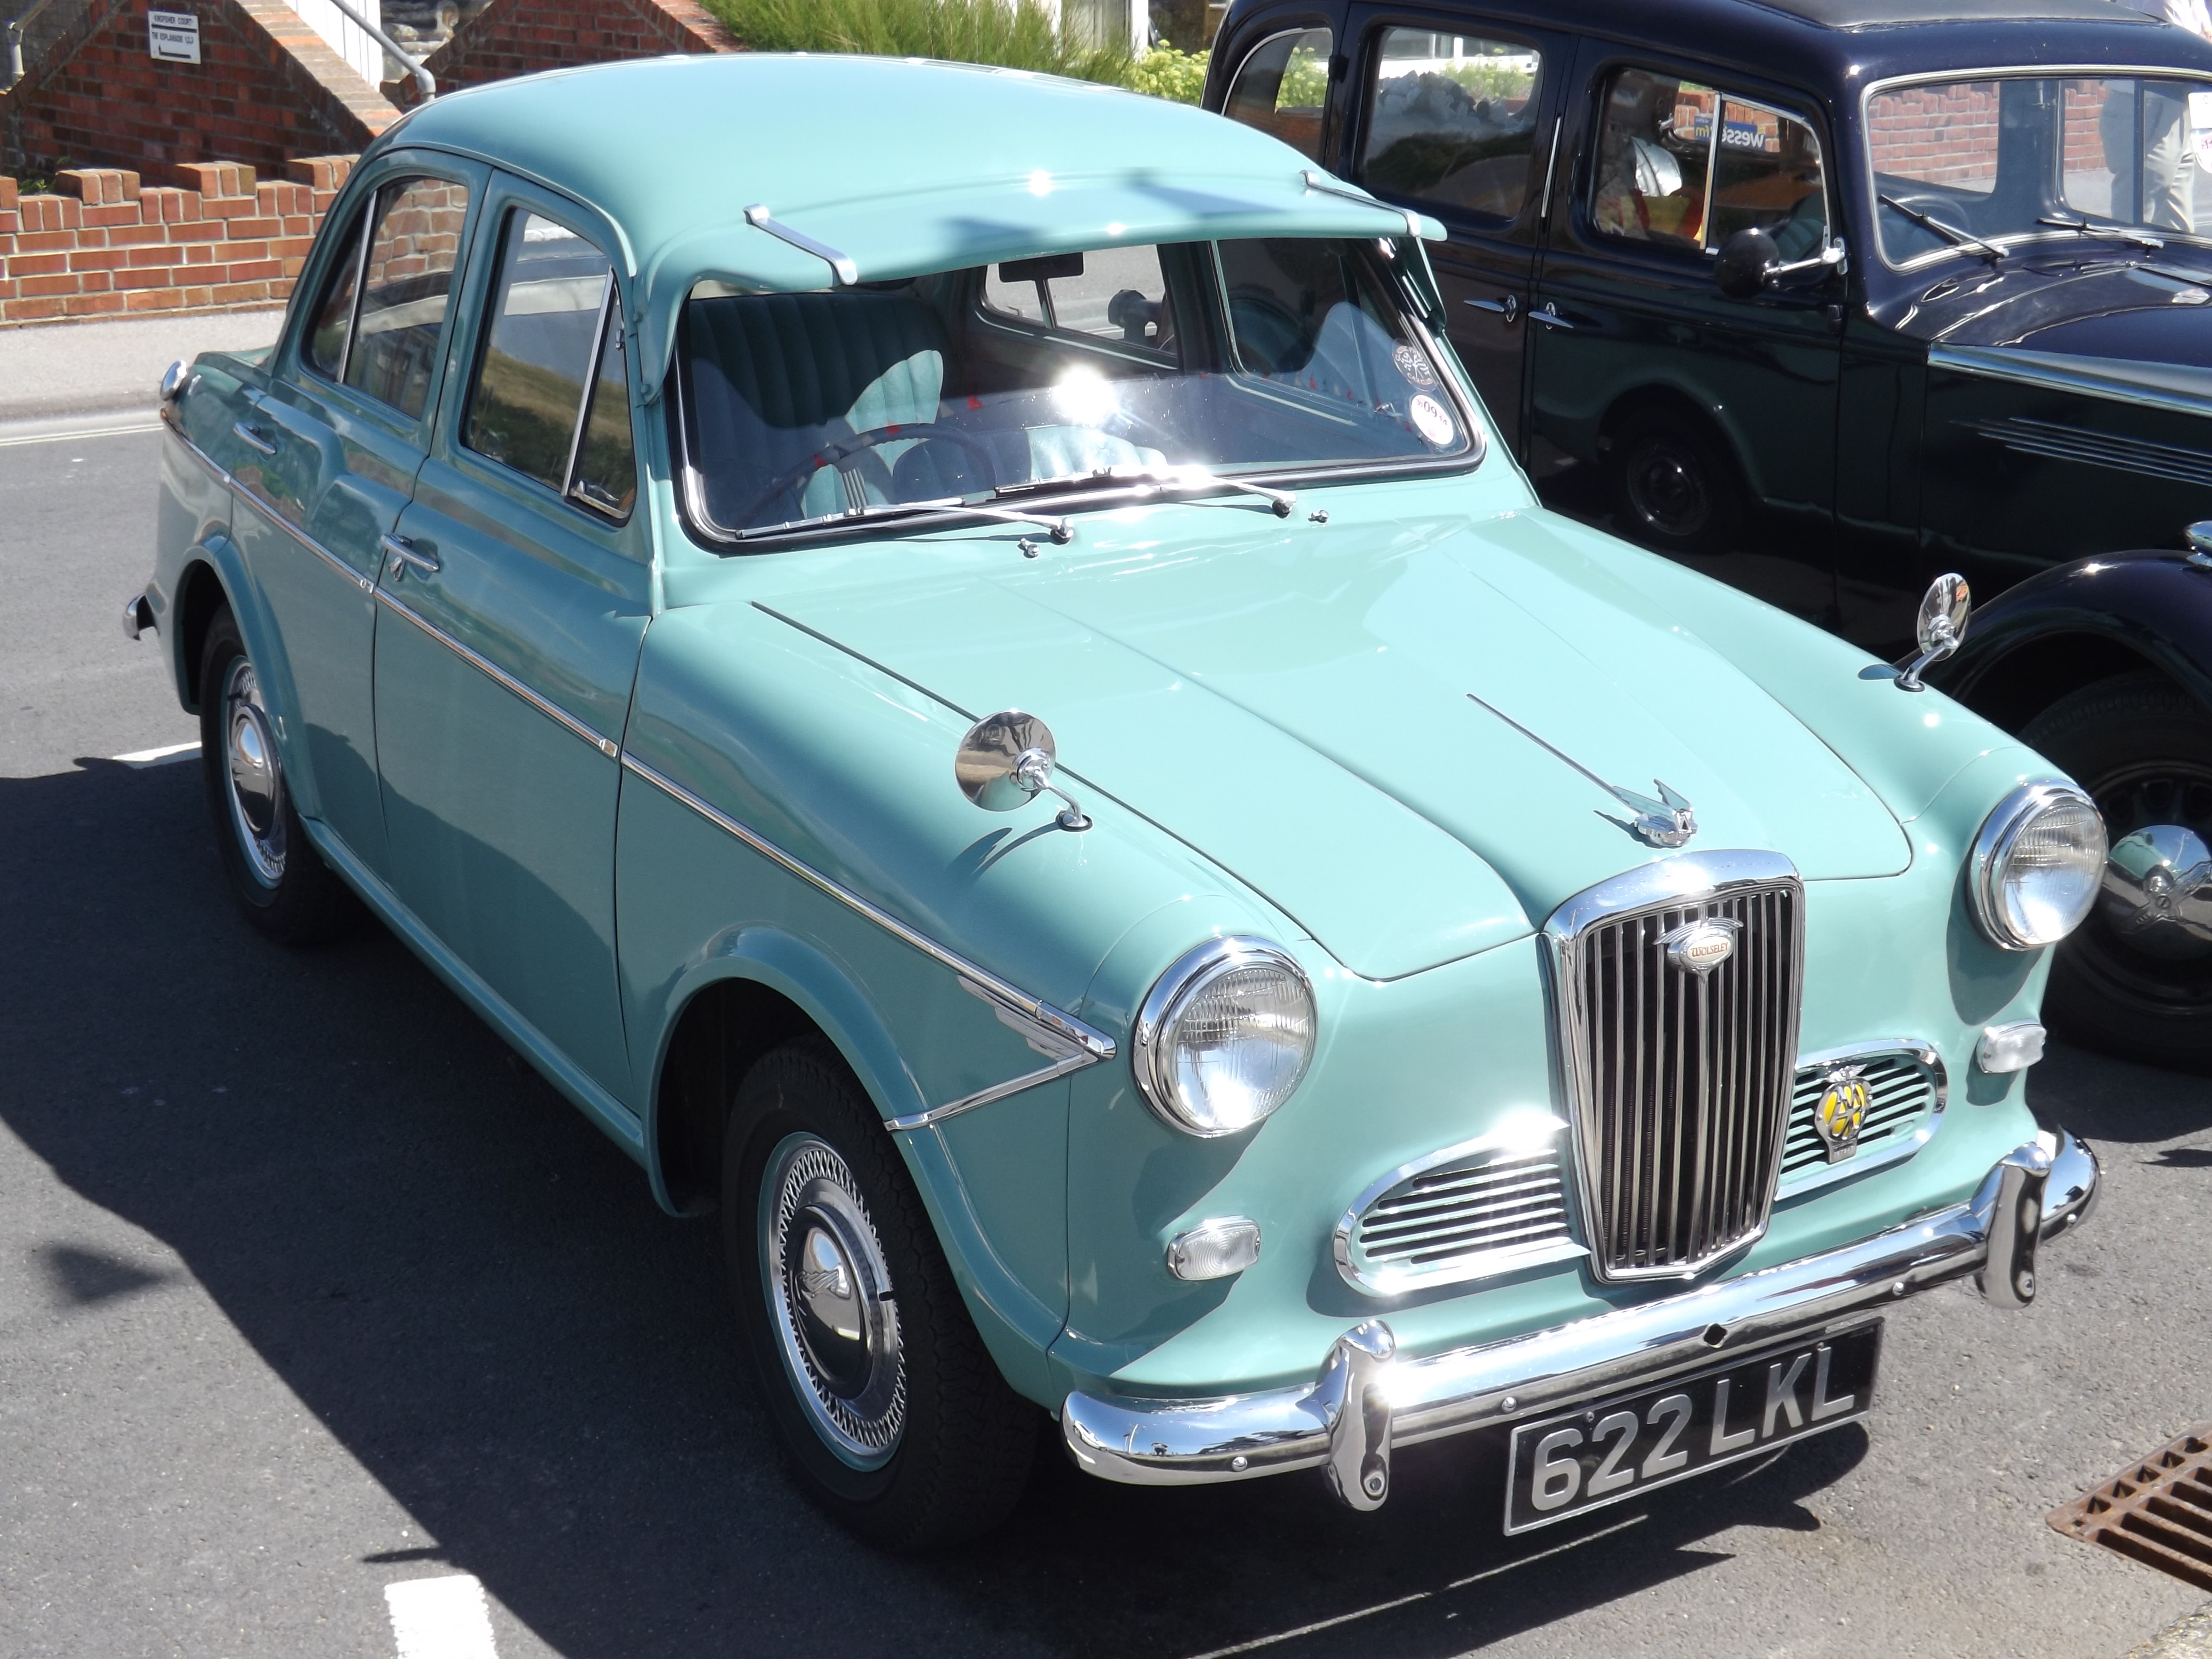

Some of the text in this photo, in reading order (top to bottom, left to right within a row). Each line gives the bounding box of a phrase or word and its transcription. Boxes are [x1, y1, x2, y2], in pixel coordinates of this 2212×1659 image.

[160, 32, 183, 43] ESPLANADE
[1424, 400, 1438, 418] 09
[1690, 941, 1729, 957] WOLSELEY
[1531, 1346, 1855, 1511] 622 LKL
